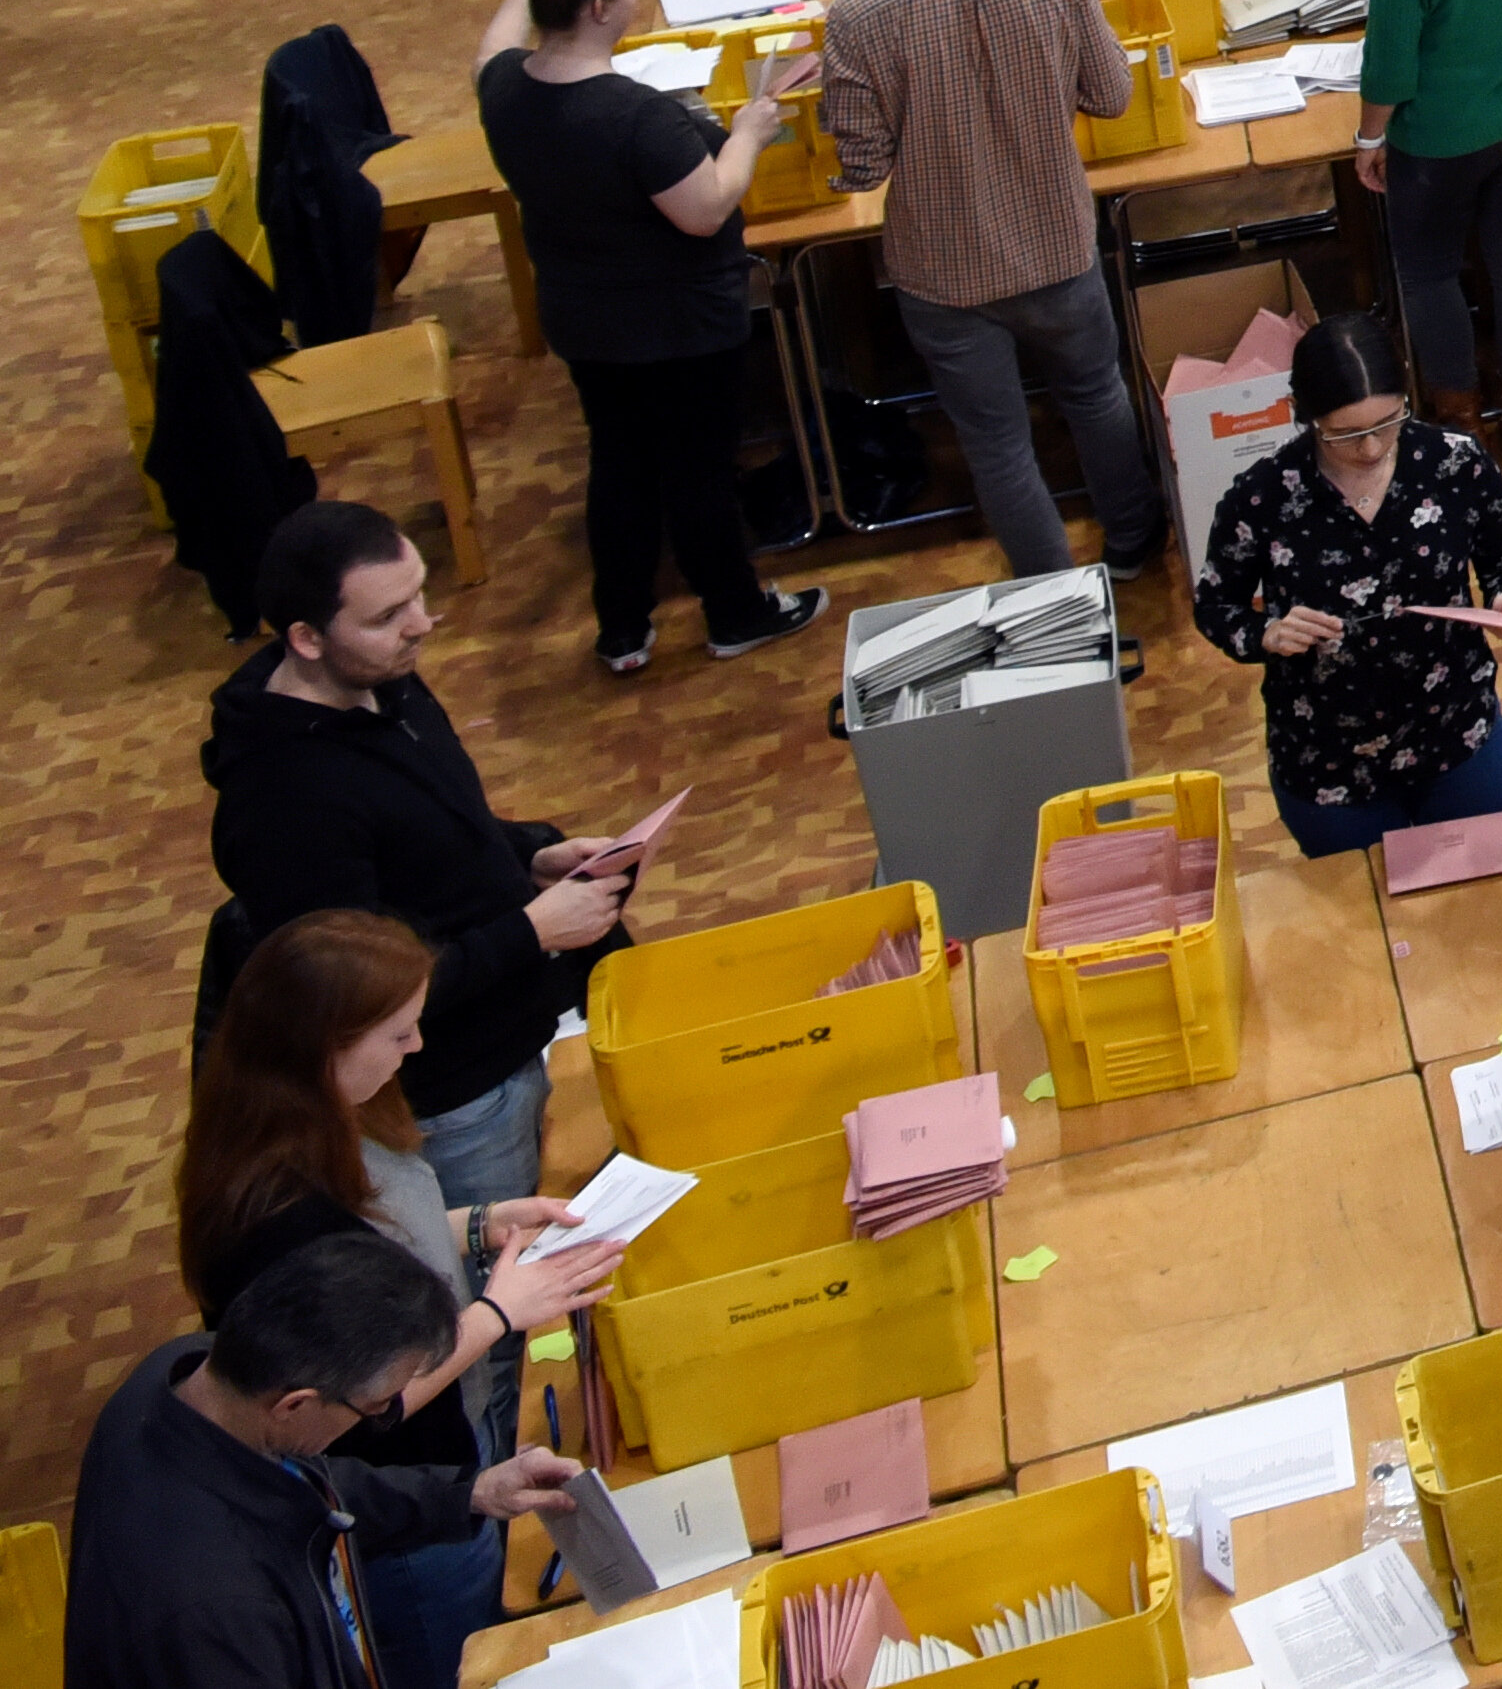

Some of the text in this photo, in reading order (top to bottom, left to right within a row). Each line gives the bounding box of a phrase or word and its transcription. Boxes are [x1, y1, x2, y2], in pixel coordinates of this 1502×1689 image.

[722, 1036, 804, 1065] Deutsche Post
[729, 1293, 819, 1325] Deutsche Post
